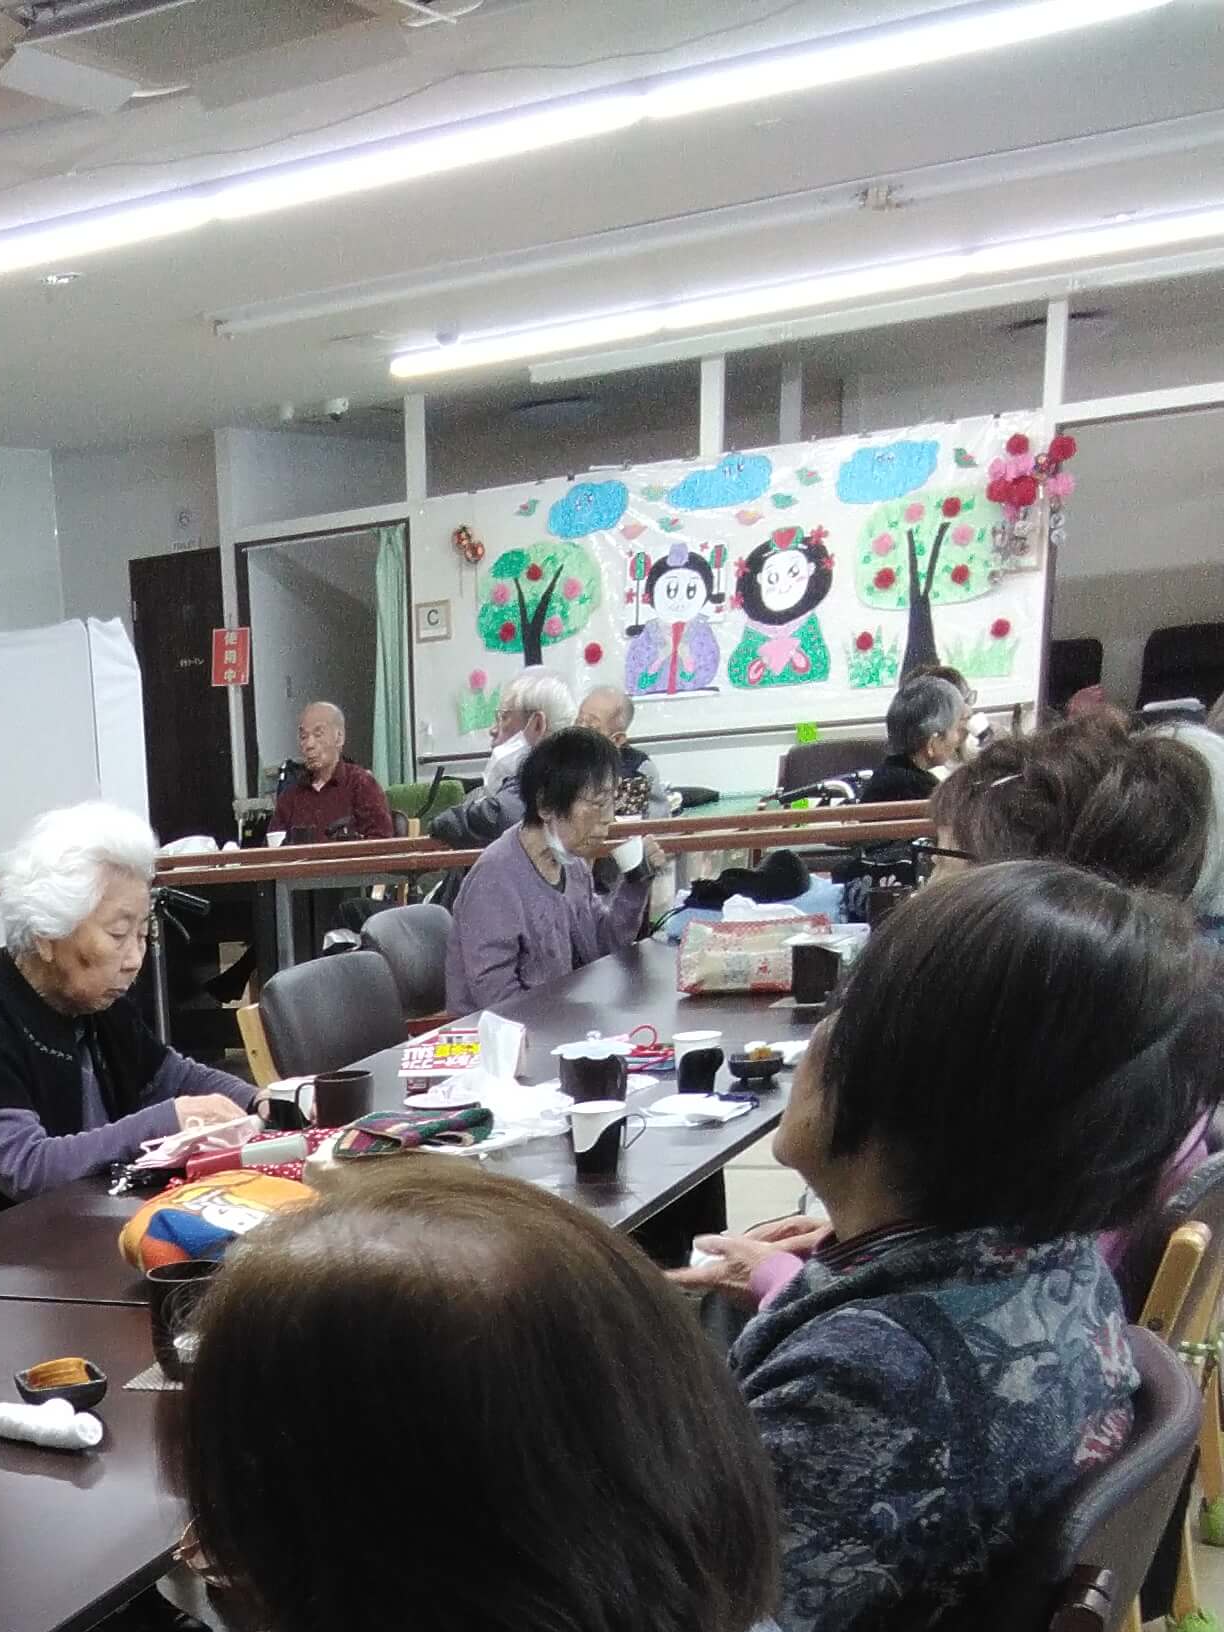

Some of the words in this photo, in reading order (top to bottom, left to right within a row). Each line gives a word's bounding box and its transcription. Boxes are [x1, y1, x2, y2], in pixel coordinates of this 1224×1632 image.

[427, 609, 439, 626] C
[224, 631, 238, 682] 使用中
